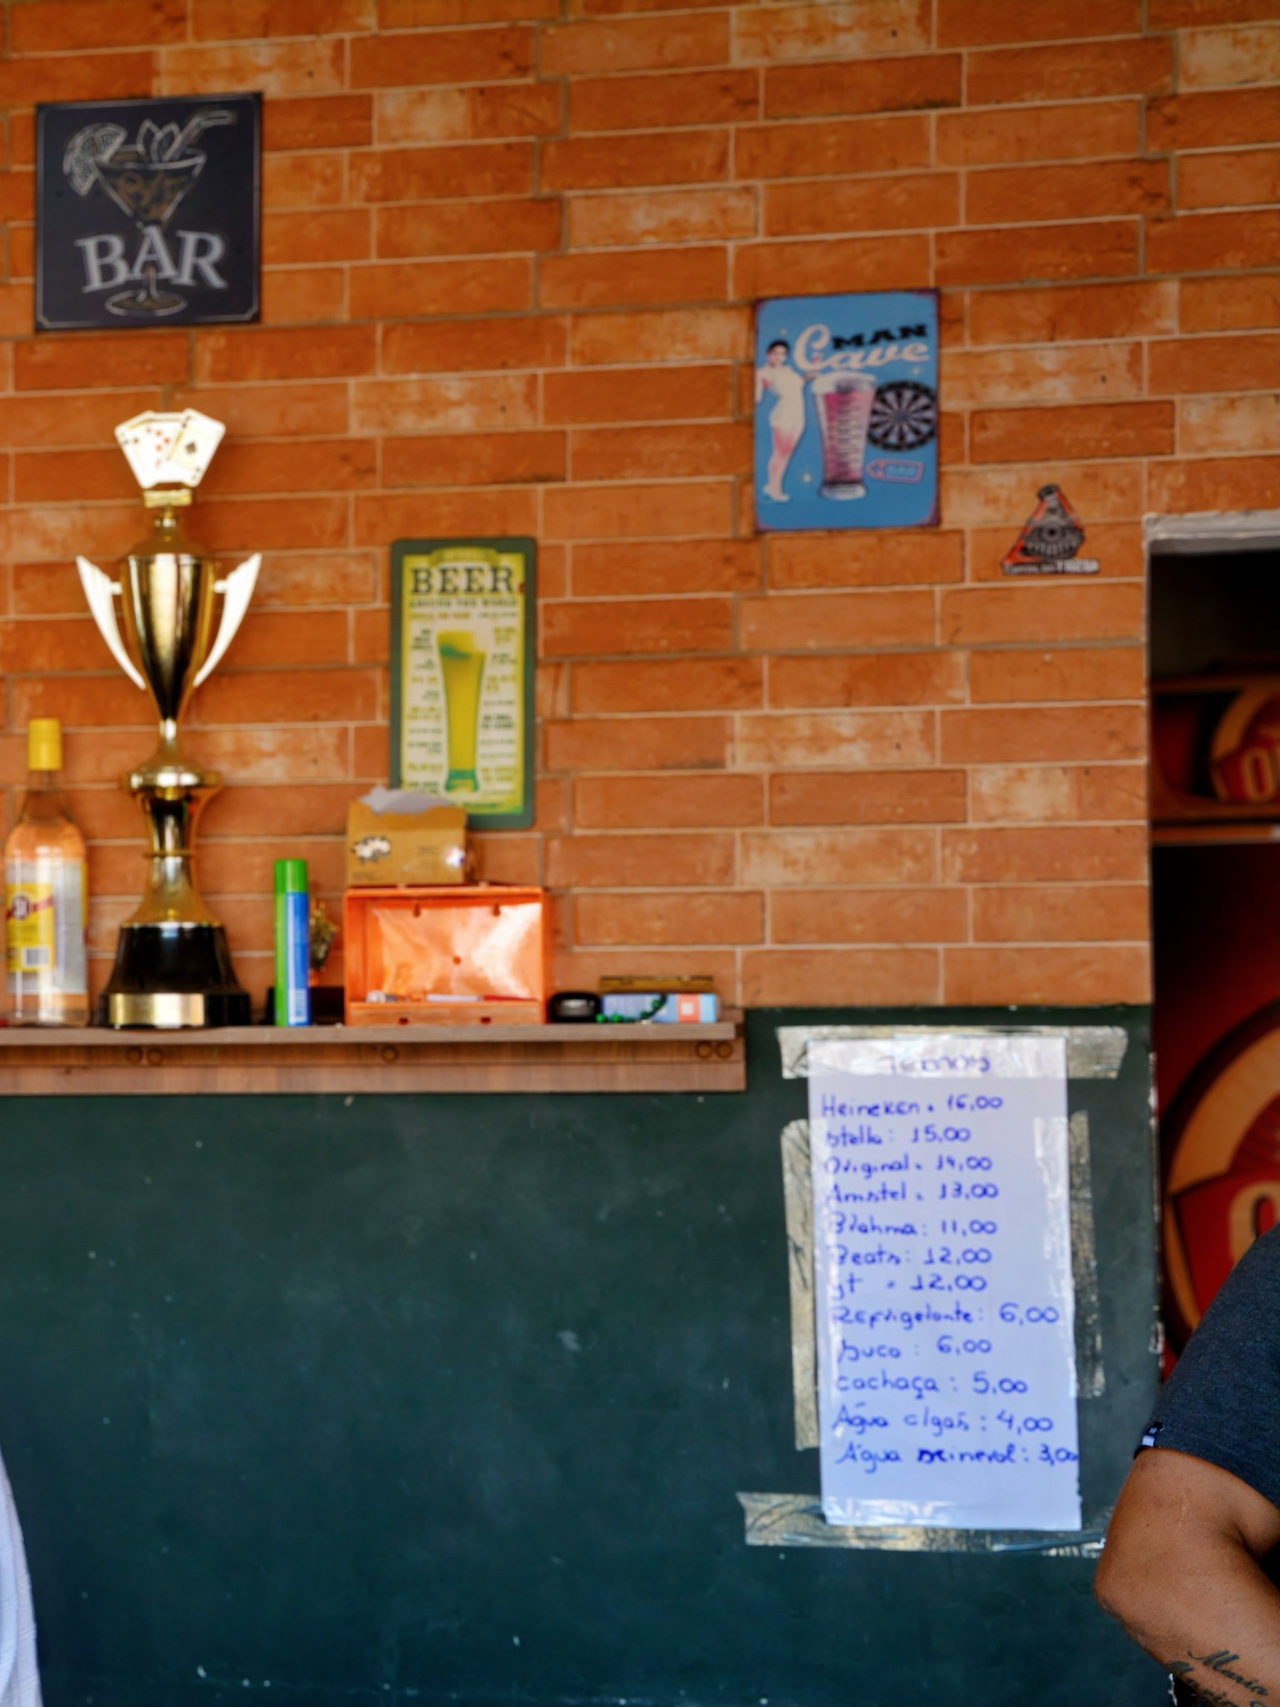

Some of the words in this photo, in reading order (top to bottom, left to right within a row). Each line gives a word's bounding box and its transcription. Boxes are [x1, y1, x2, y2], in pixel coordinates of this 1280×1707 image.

[73, 225, 229, 293] BAR
[792, 324, 932, 372] Cave
[831, 323, 929, 351] MAN
[410, 566, 515, 595] BEER
[998, 1302, 1060, 1327] 6,00
[996, 1409, 1054, 1436] 4,00
[834, 1441, 902, 1475] Água
